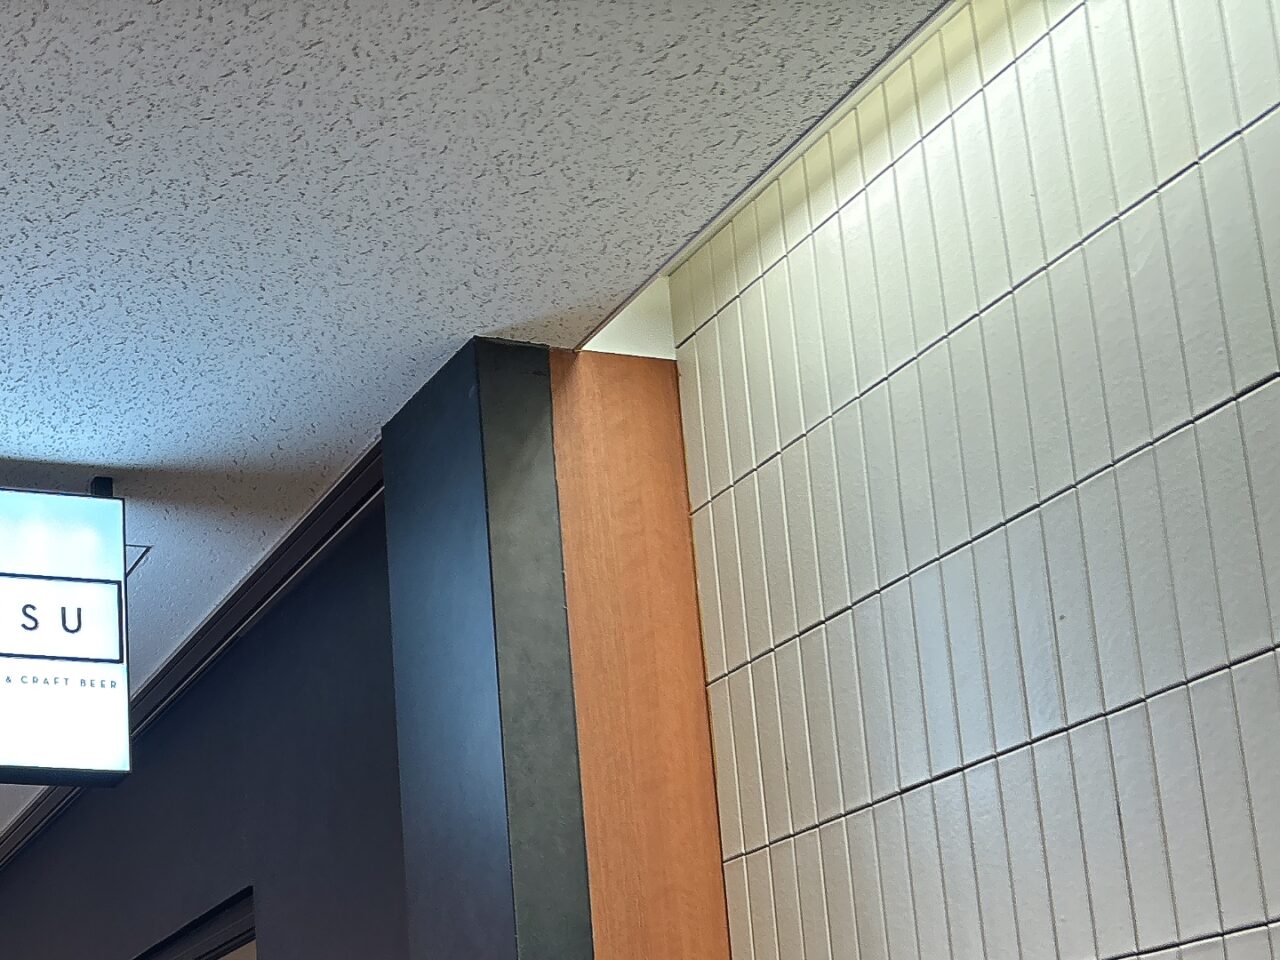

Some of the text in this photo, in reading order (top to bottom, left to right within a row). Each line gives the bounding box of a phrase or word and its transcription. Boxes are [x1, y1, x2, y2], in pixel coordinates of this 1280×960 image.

[5, 675, 12, 684] &
[20, 675, 69, 686] CRAFT
[80, 678, 117, 689] BEER
